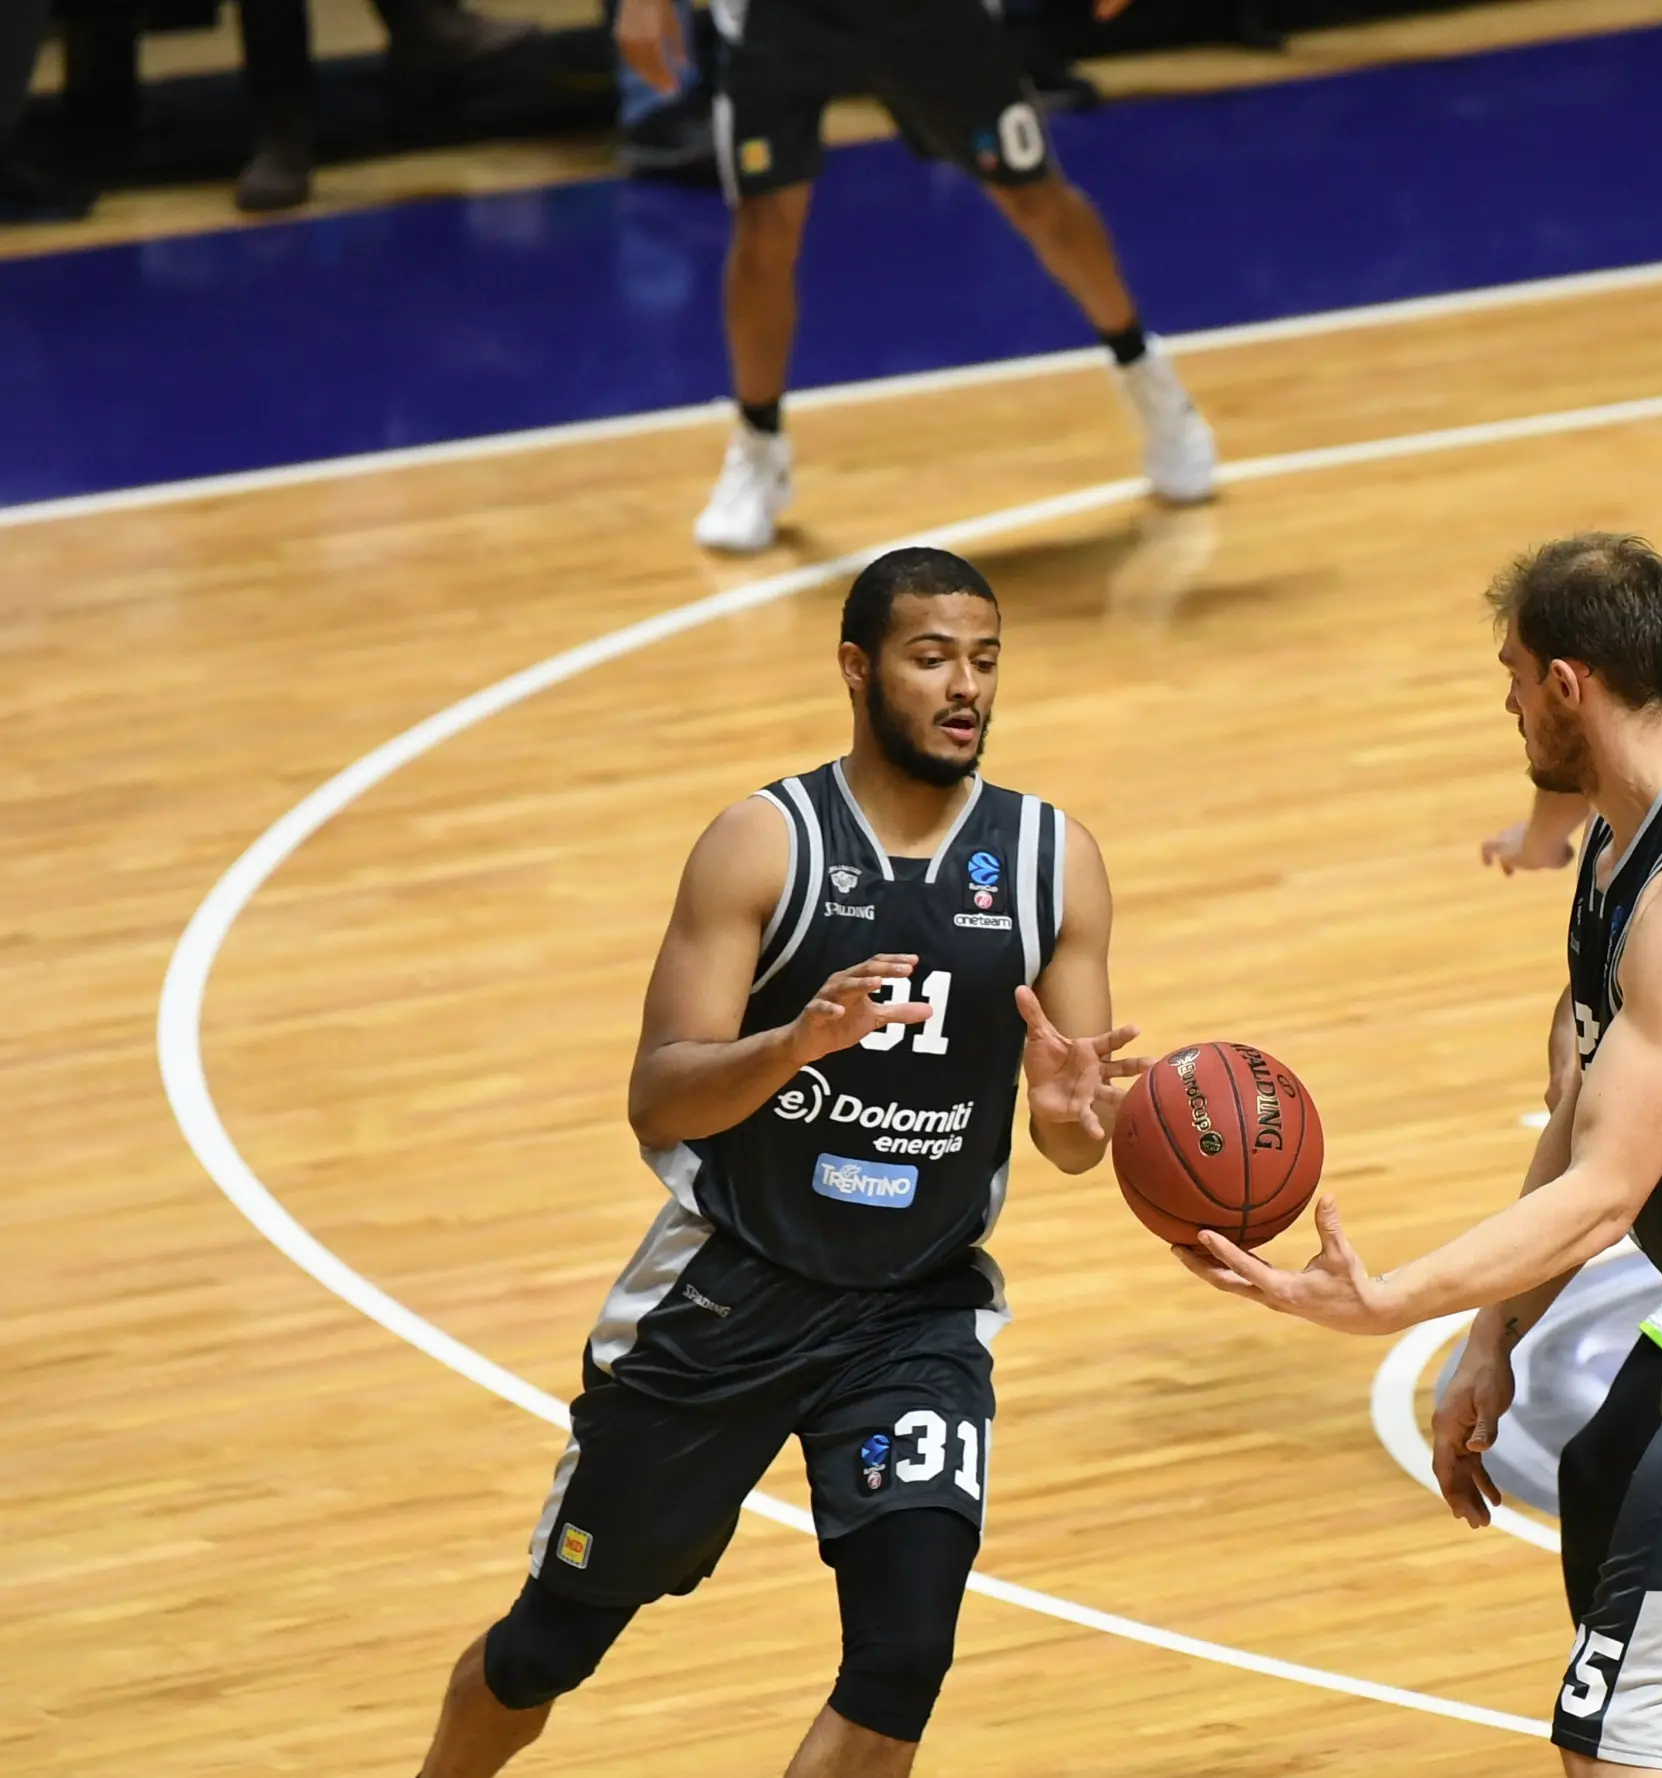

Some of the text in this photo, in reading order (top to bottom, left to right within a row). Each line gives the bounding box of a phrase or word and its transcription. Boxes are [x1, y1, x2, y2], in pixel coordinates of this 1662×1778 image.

[998, 102, 1044, 171] 0
[859, 970, 952, 1055] 31
[829, 1094, 975, 1133] Dolomiti
[1178, 1062, 1211, 1132] EuroCup
[821, 1163, 911, 1197] TRENTINO
[872, 1134, 964, 1160] energia
[894, 1410, 980, 1501] 31
